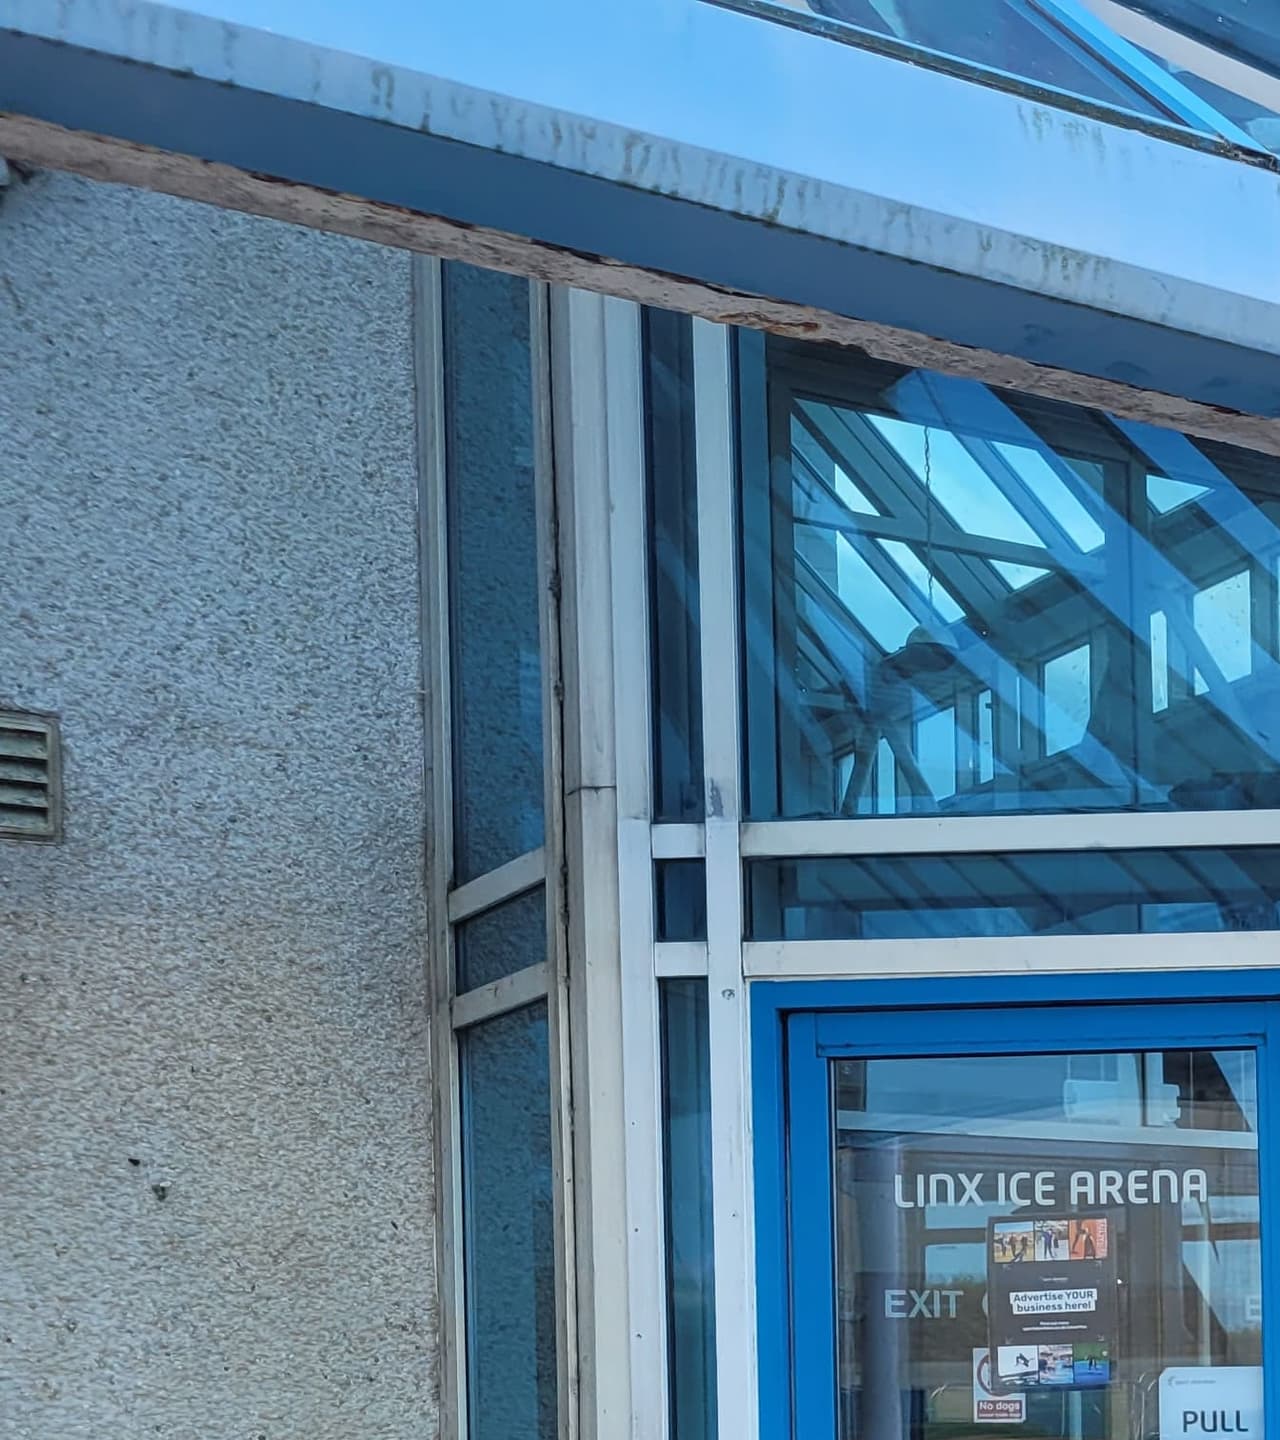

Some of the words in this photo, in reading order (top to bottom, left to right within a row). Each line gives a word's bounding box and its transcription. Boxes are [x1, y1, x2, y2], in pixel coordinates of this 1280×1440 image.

[894, 1172, 984, 1209] LINX
[997, 1170, 1056, 1206] ICE
[1070, 1168, 1208, 1205] ARENA
[884, 1288, 964, 1319] EXIT
[1013, 1293, 1063, 1303] Advertise
[1065, 1290, 1094, 1300] YOUR
[1016, 1301, 1063, 1312] business
[1065, 1299, 1092, 1310] here!
[979, 1401, 994, 1410] No
[995, 1401, 1021, 1413] dogs
[1182, 1409, 1249, 1433] PULL
